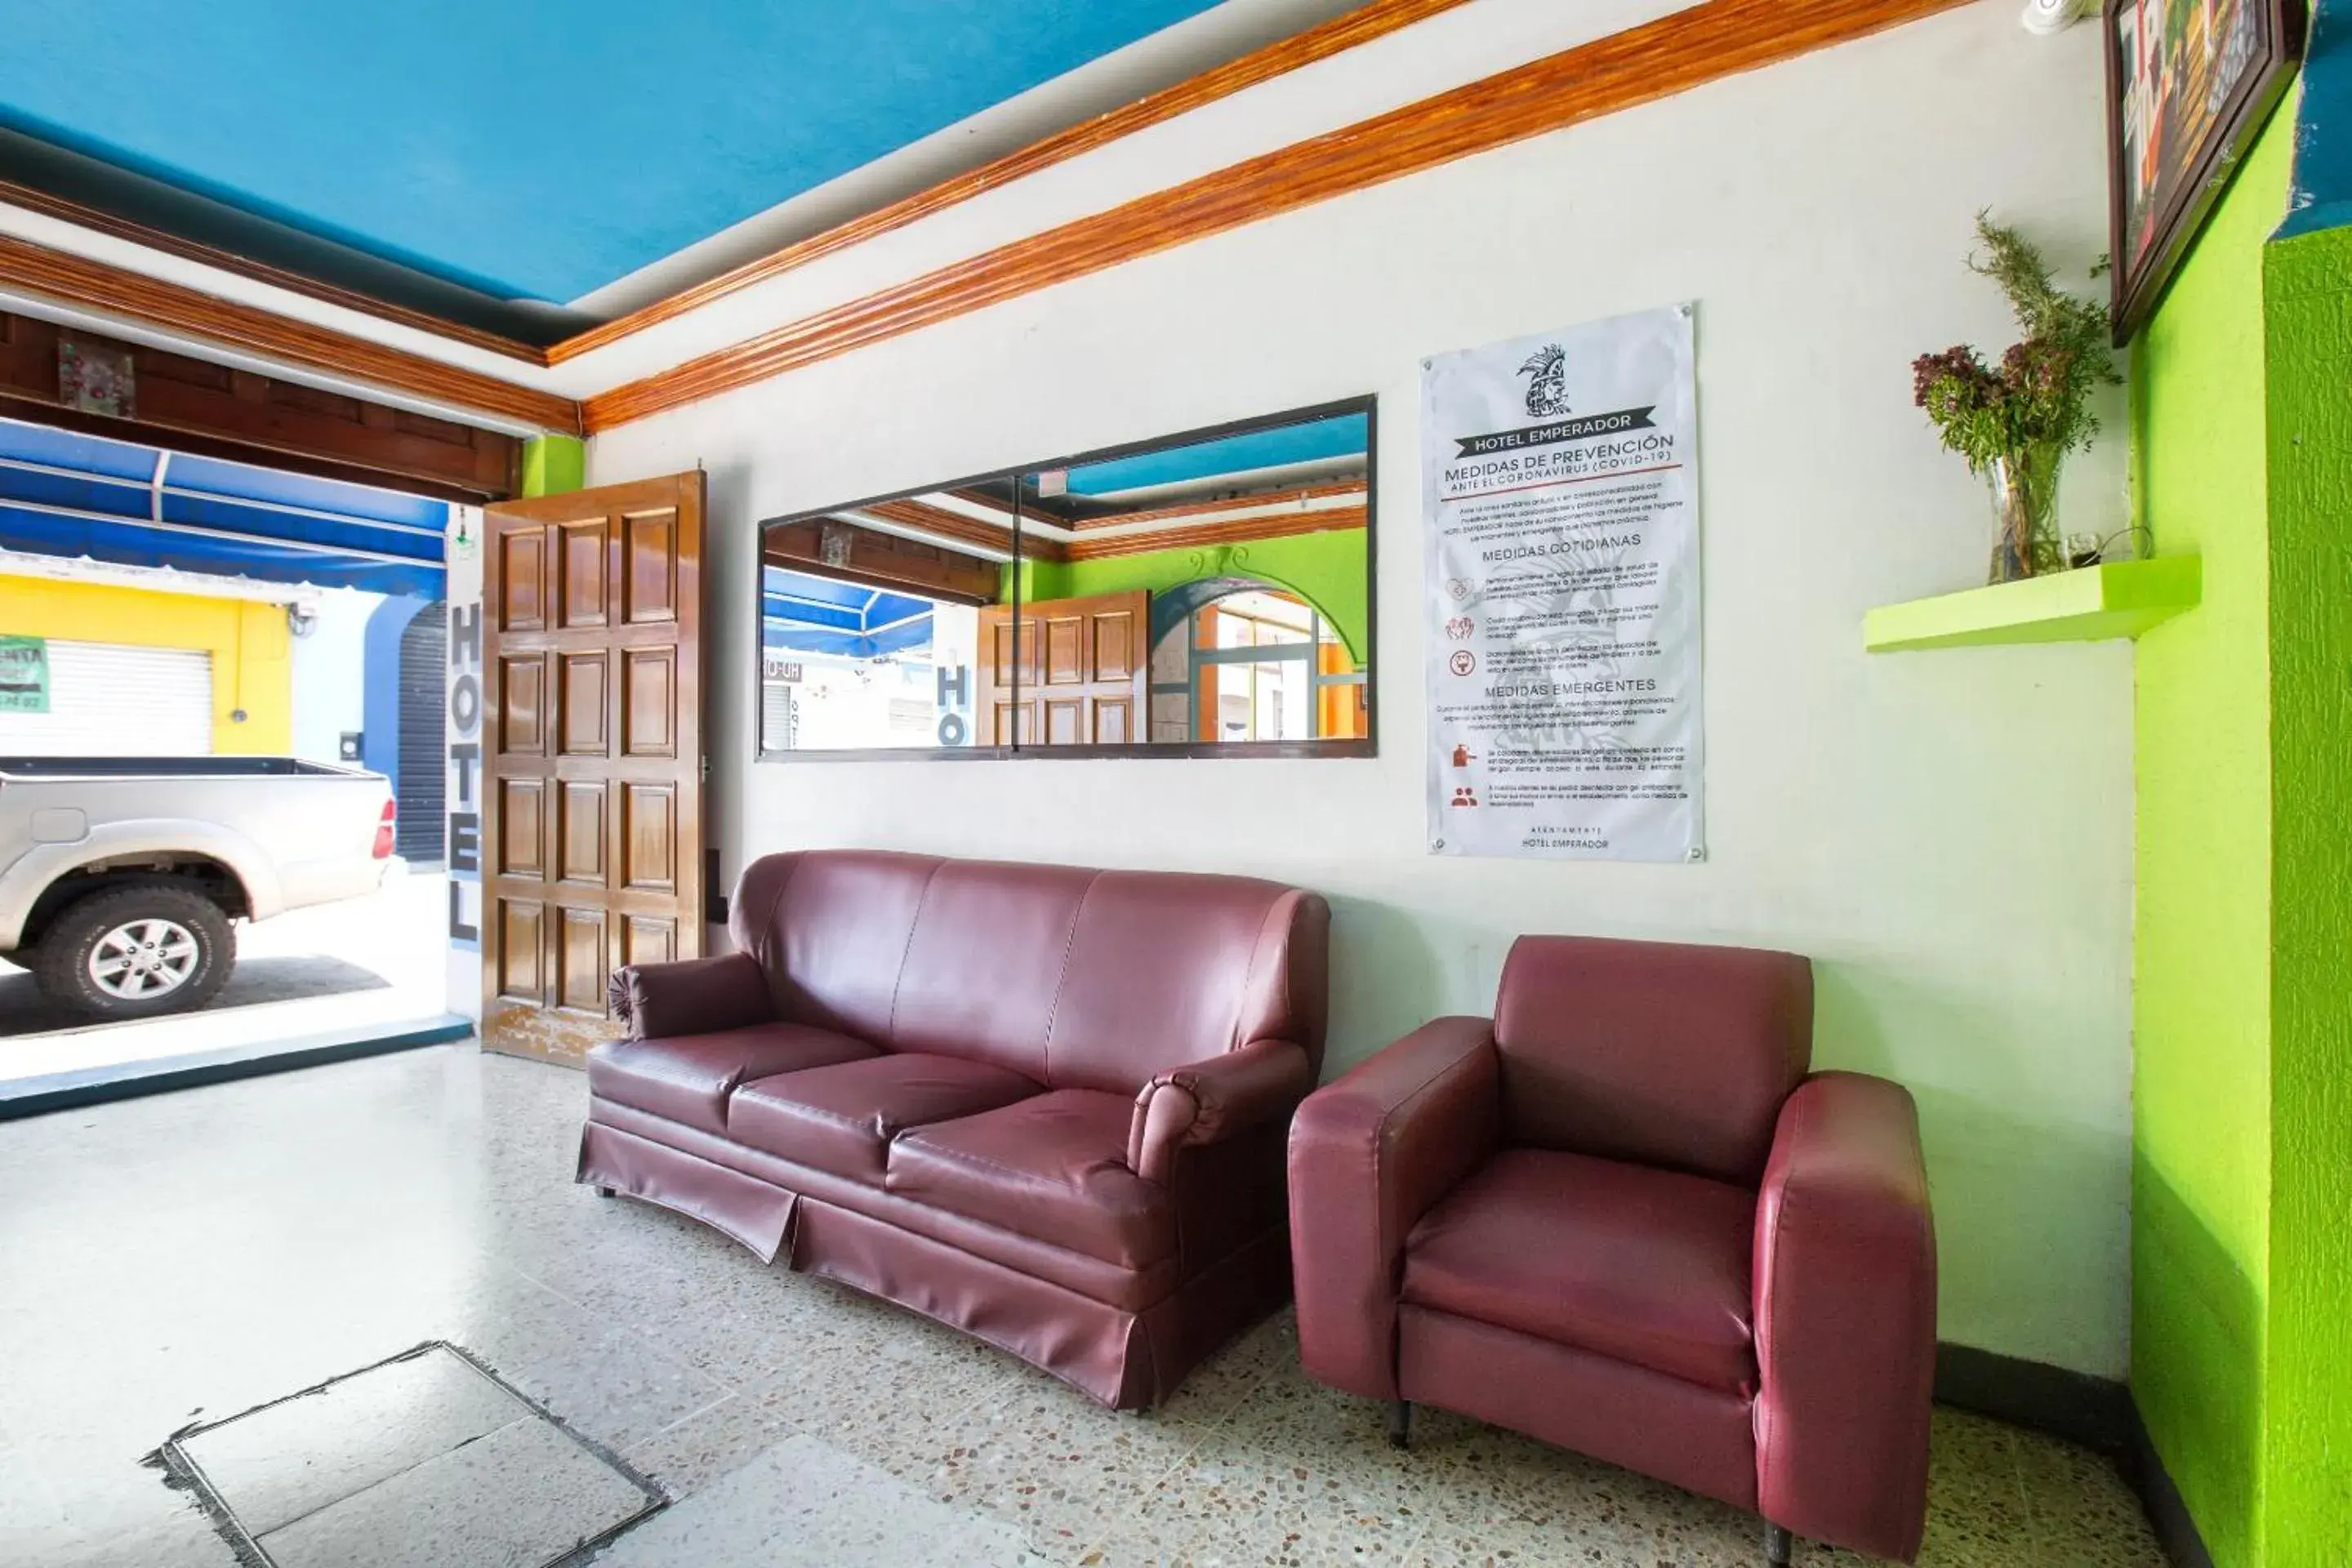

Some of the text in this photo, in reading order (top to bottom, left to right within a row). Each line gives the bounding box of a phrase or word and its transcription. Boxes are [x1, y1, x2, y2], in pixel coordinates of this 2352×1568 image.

[1474, 413, 1632, 452] HOTEL EMPERADOR
[1444, 434, 1674, 483] MEDIDAS DE PREVENCIÓN
[1450, 451, 1671, 492] ANTE EL CORONAVIRUS (COVID-19)
[1481, 534, 1642, 563] MEDIDAS COTIDIANAS
[1485, 679, 1657, 699] MEDIDAS EMERGENTES
[450, 602, 480, 942] HOTEL
[1521, 838, 1609, 849] HOTEL EMPERADOR
